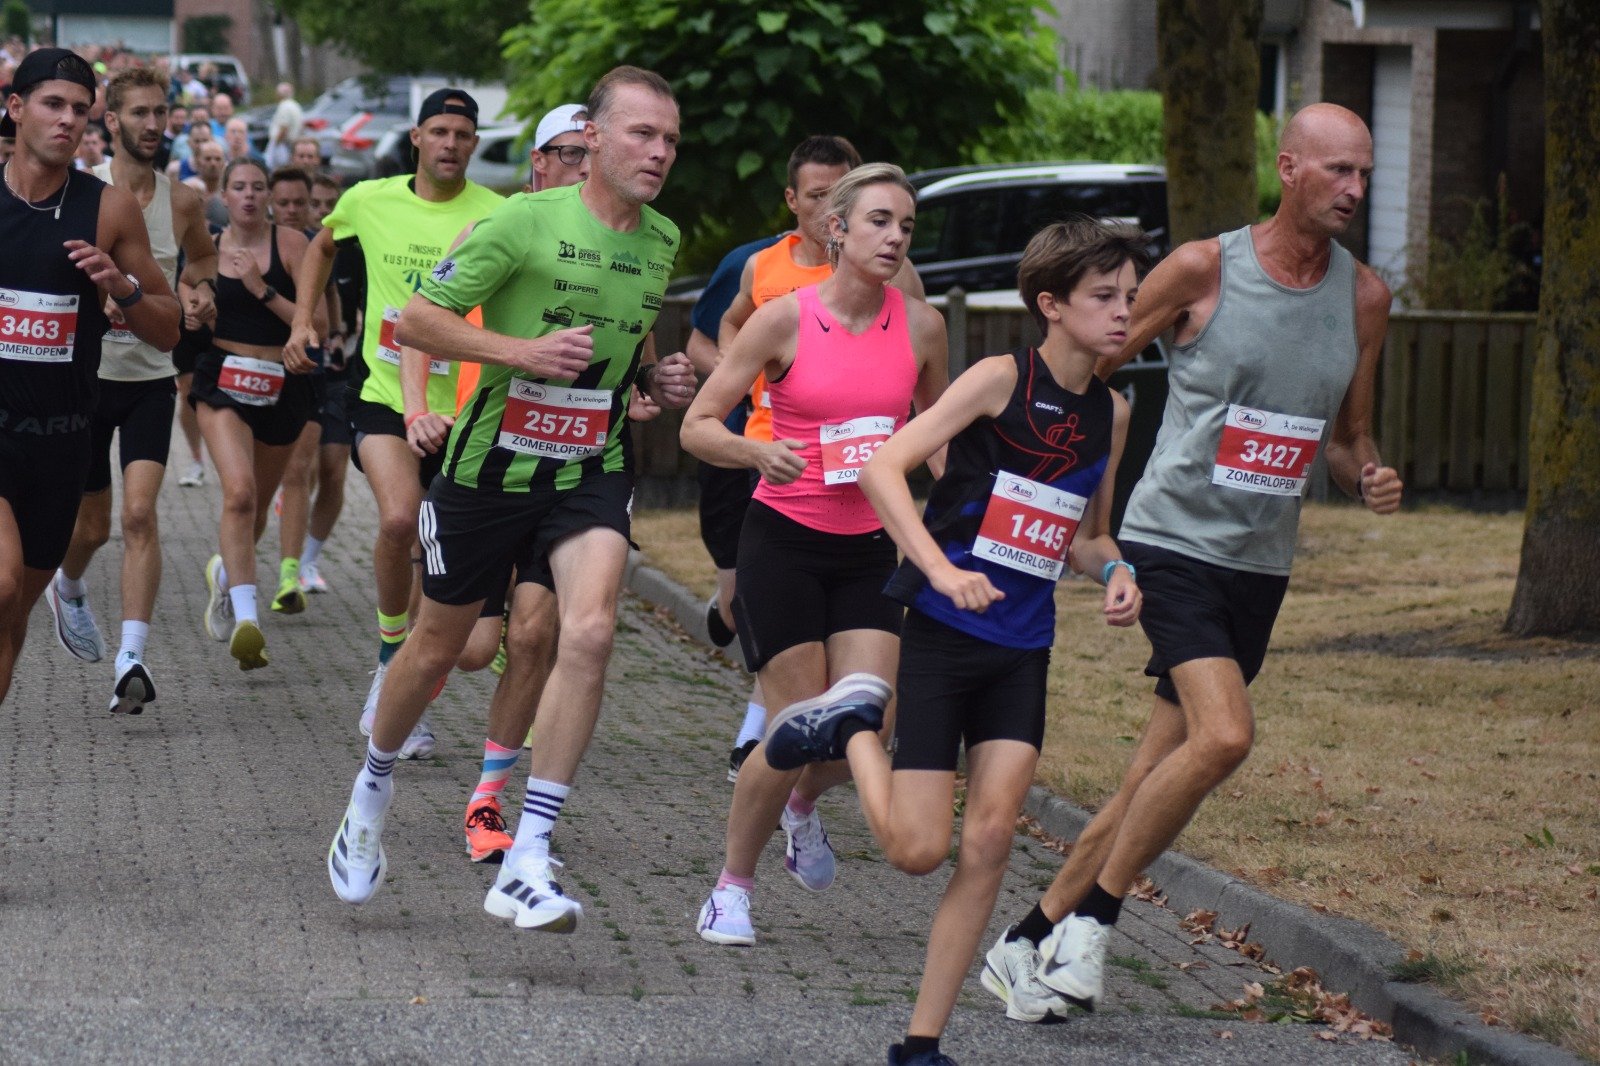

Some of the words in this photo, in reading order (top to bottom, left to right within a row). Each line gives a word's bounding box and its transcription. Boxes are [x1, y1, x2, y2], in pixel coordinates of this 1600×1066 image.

[407, 243, 443, 256] FINISHER
[578, 250, 602, 261] press
[609, 260, 642, 276] Athlex
[555, 279, 567, 291] IT
[568, 284, 599, 295] EXPERTS
[1, 315, 60, 340] 3463
[0, 342, 65, 356] OMERLOPEN
[233, 373, 271, 392] 1426
[1035, 401, 1059, 412] CRAFT
[523, 410, 589, 438] 2575
[511, 435, 593, 456] ZOMERLOPEN
[842, 441, 886, 464] 25
[1239, 439, 1302, 470] 3427
[1225, 468, 1298, 490] ZOMERLOPEN
[1011, 514, 1068, 551] 1445
